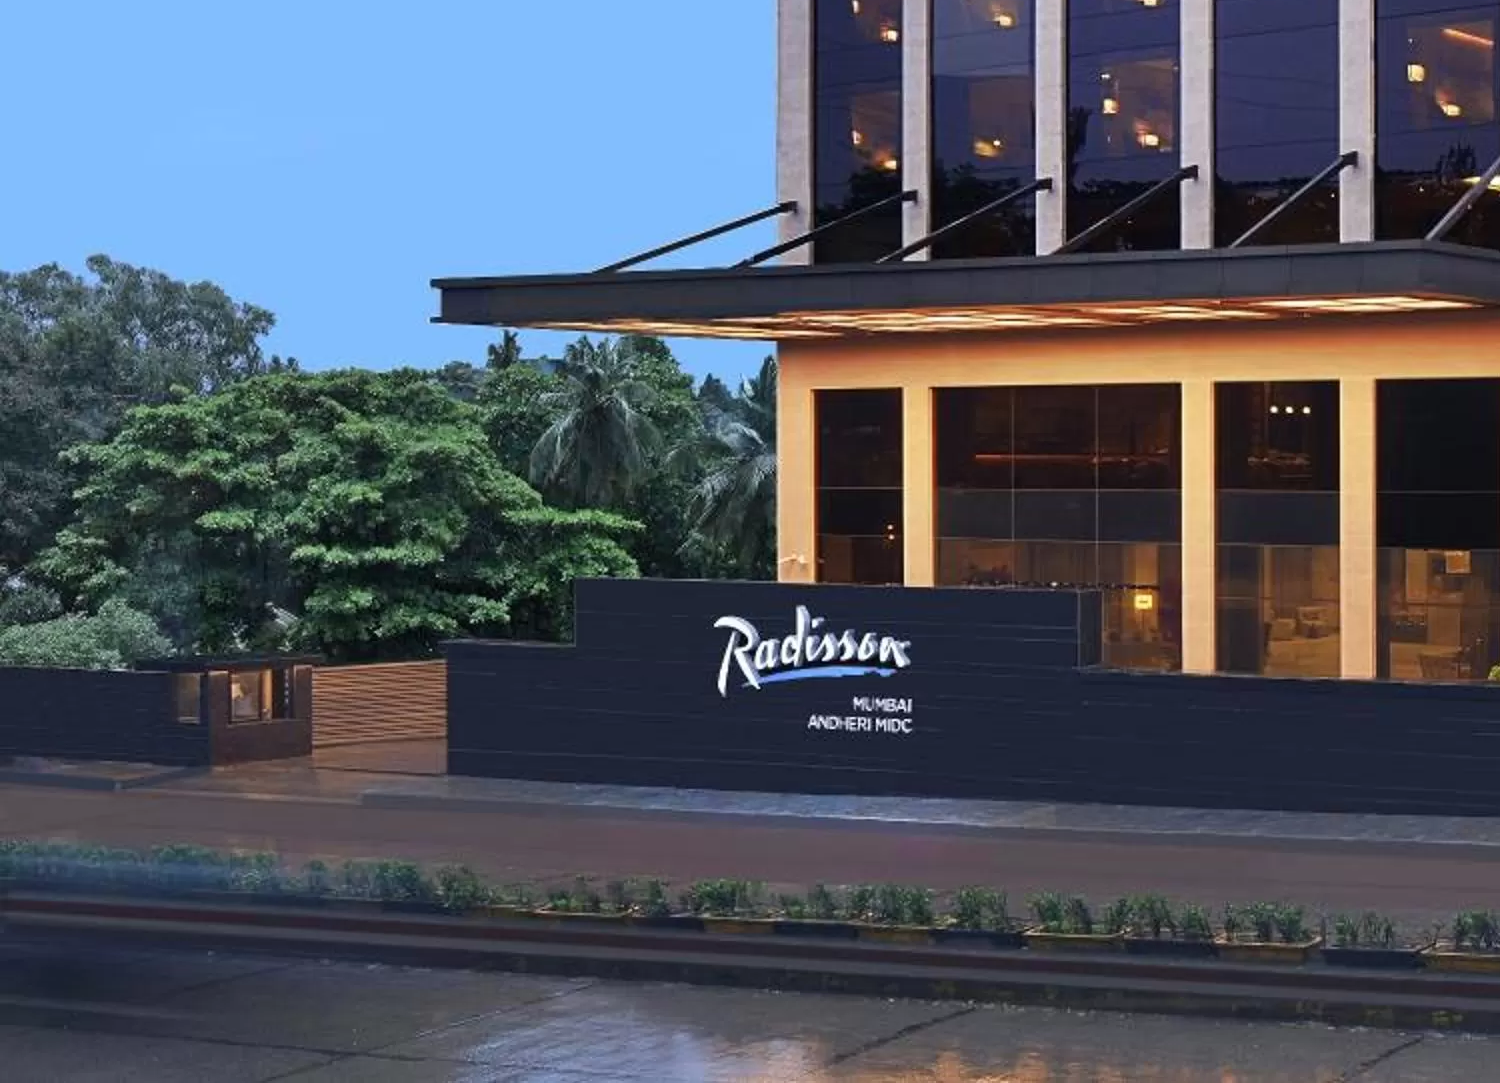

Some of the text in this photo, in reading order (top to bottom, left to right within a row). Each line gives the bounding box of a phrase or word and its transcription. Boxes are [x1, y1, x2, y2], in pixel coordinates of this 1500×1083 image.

[713, 605, 912, 697] Radisson
[853, 696, 913, 713] MUMBAI
[807, 714, 913, 733] ANDHERI MIDC
